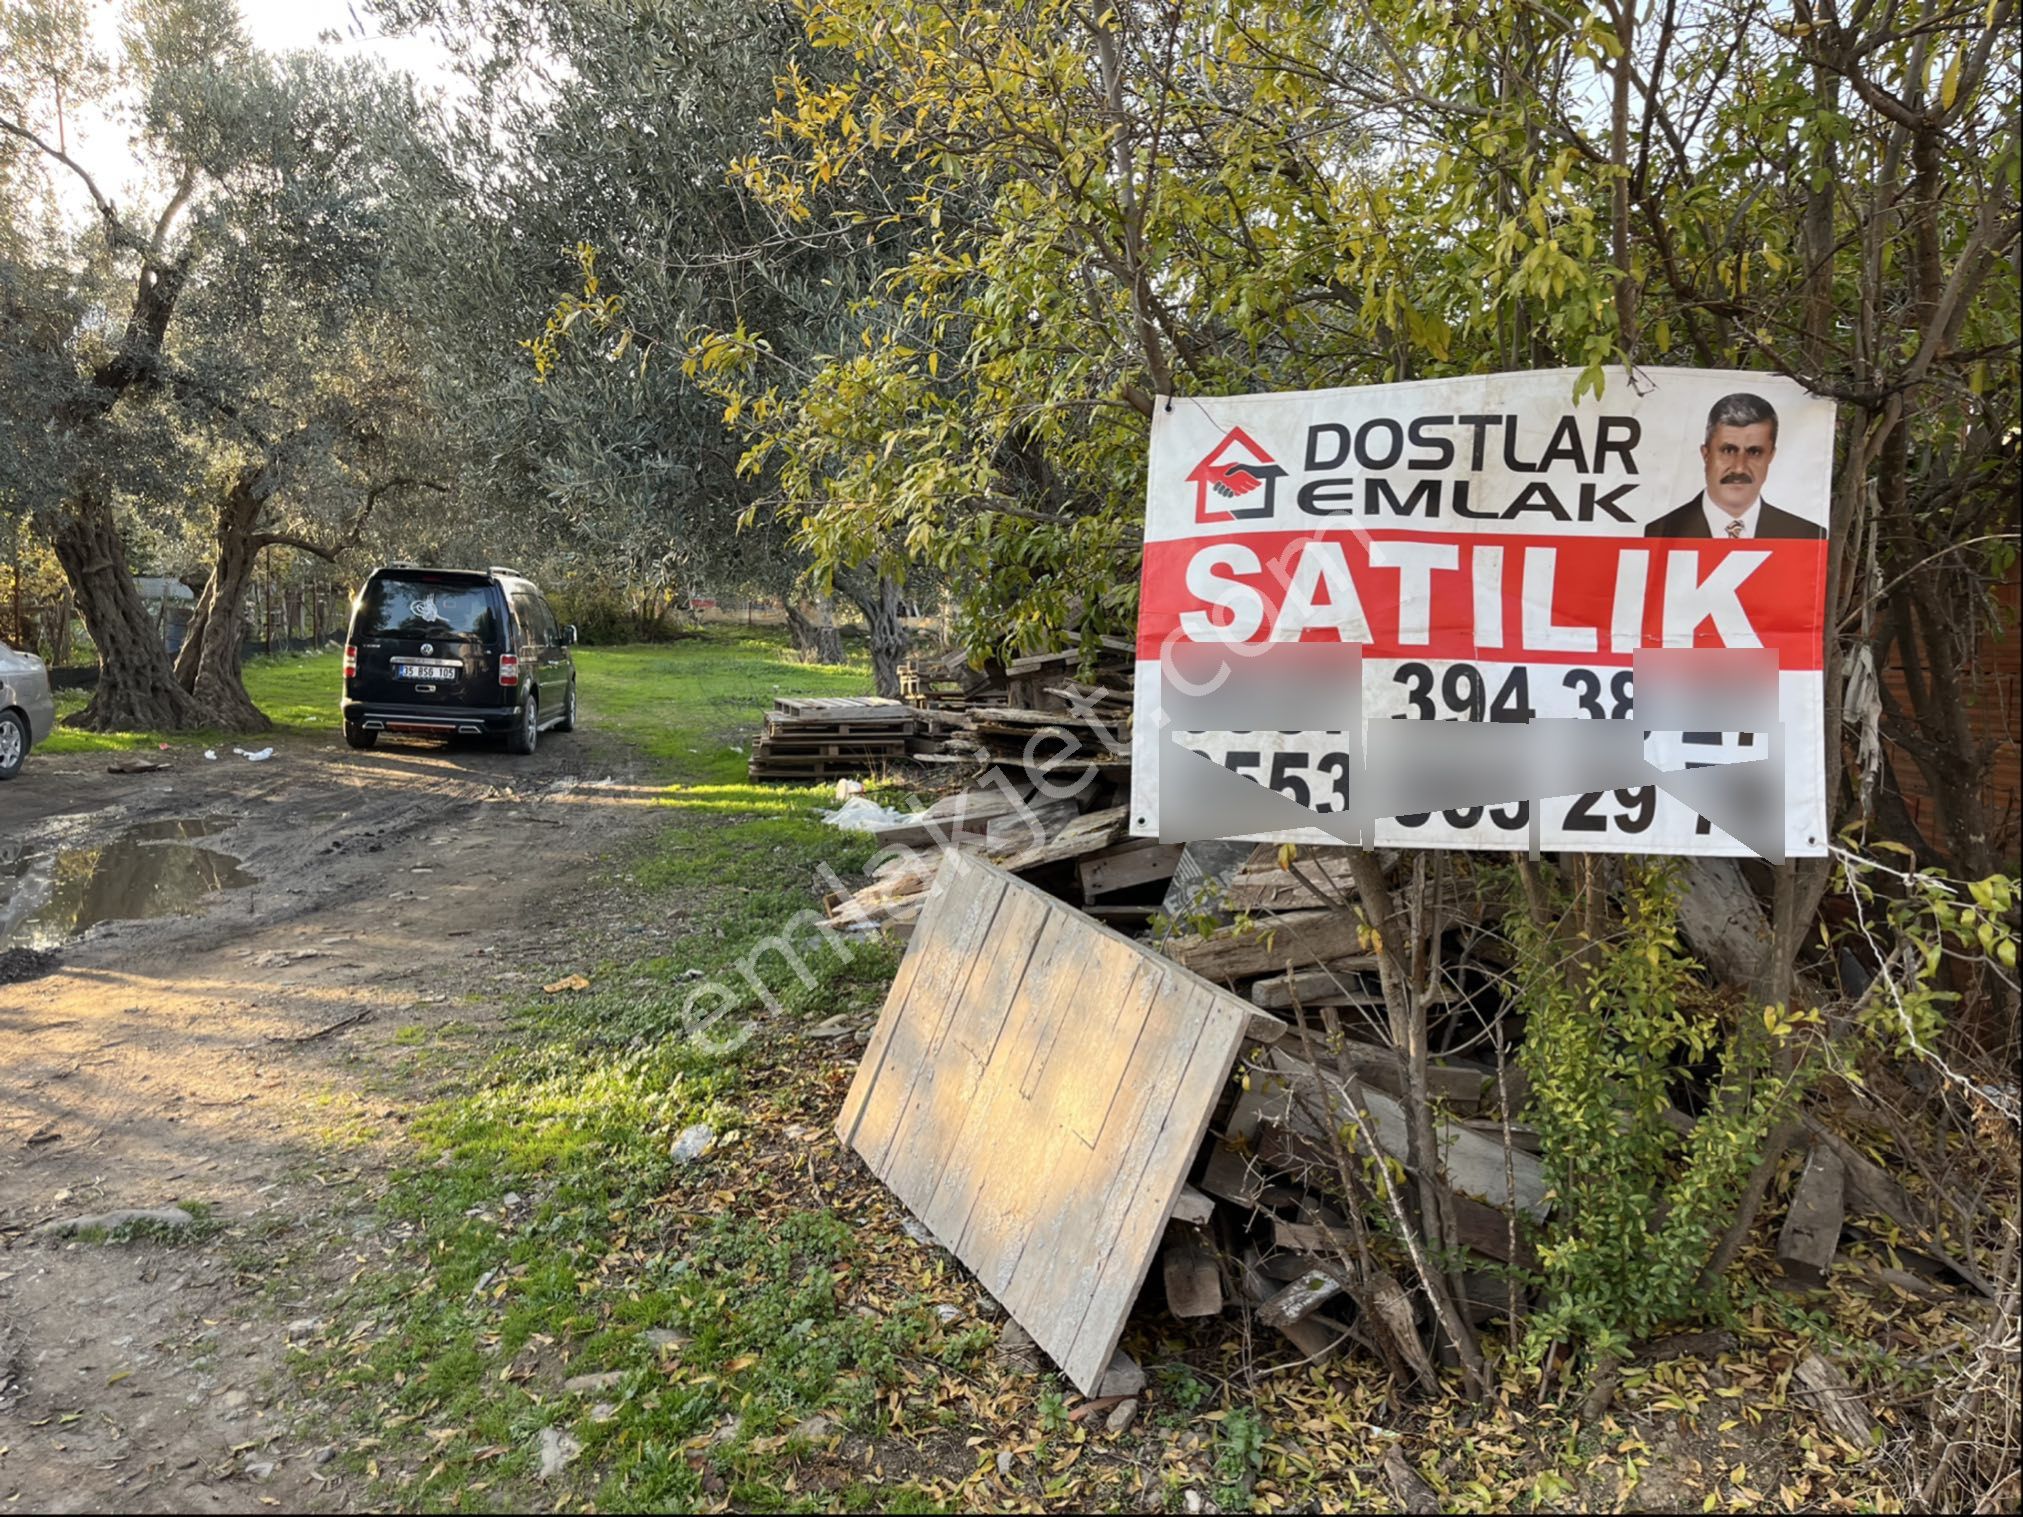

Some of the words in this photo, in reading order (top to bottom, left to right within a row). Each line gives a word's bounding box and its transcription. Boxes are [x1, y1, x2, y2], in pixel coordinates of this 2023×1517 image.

[1305, 414, 1642, 475] DOSTLAR
[1296, 477, 1638, 524] EMLAK
[1178, 540, 1773, 653] SATILIK
